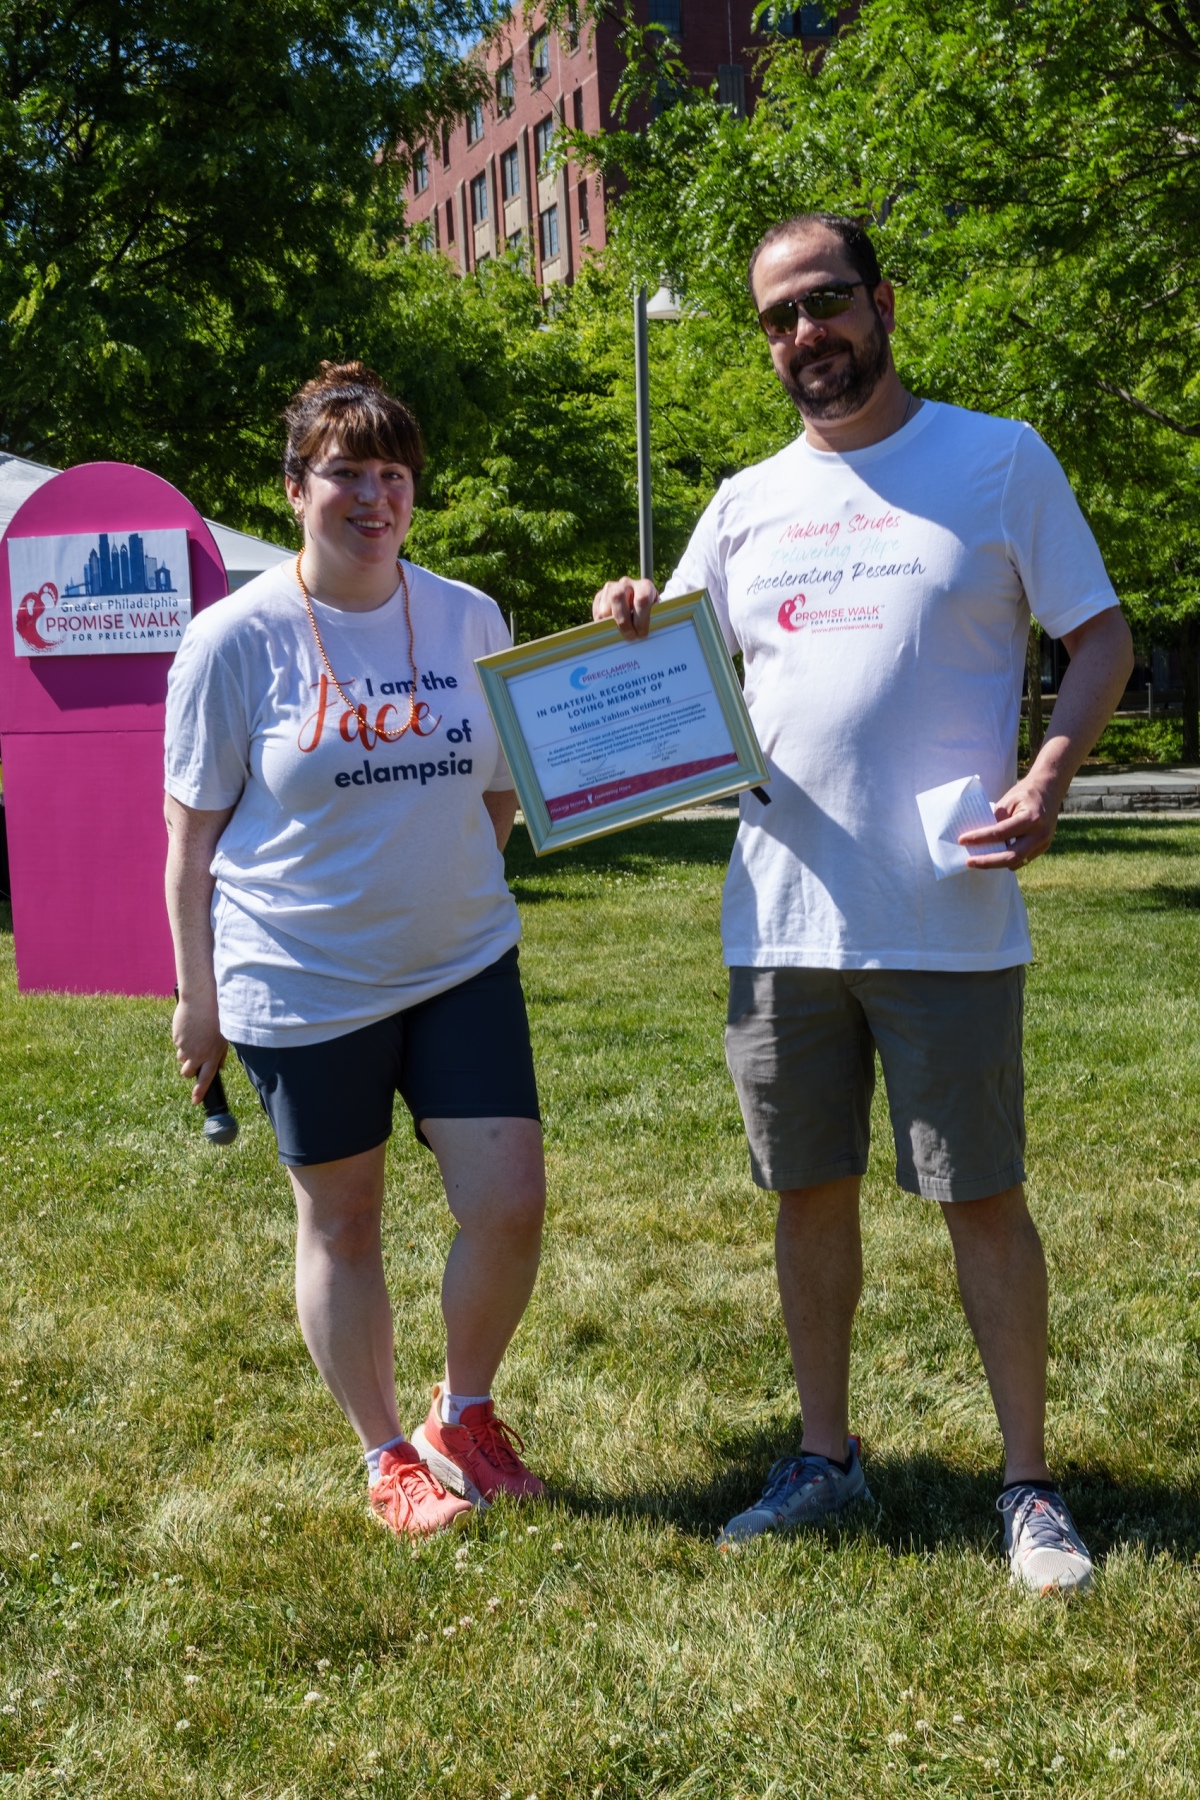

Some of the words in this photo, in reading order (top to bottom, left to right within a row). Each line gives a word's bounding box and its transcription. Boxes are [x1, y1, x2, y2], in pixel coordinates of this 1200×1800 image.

[779, 520, 840, 546] Making
[848, 510, 901, 534] Strides
[769, 543, 851, 567] Delivering
[860, 536, 900, 560] Hope
[746, 566, 844, 595] Accelerating
[852, 556, 927, 581] Research
[61, 601, 103, 613] Greater
[107, 597, 178, 612] Philadelphia
[795, 609, 845, 621] PROMISE
[46, 613, 124, 633] PROMISE
[811, 622, 884, 634] www.promisewalk.org
[827, 615, 880, 624] PREECLAMPSIA
[72, 633, 93, 642] FOR
[98, 629, 182, 641] PREECLAMPSIA
[365, 678, 374, 697] I
[380, 680, 418, 695] am
[421, 671, 458, 691] the
[582, 660, 639, 683] PREECLAMPSIA
[536, 708, 547, 718] IN
[550, 693, 597, 713] GRATEFUL
[599, 670, 665, 698] RECOGNITION
[668, 663, 687, 676] AND
[567, 701, 604, 719] LOVING
[606, 686, 647, 706] MEMORY
[650, 682, 662, 692] OF
[297, 673, 442, 753] Face
[446, 718, 472, 744] of
[569, 719, 600, 734] Melissa
[601, 708, 630, 723] Yablon
[631, 695, 671, 713] Weinberg
[334, 751, 473, 788] eclampsia
